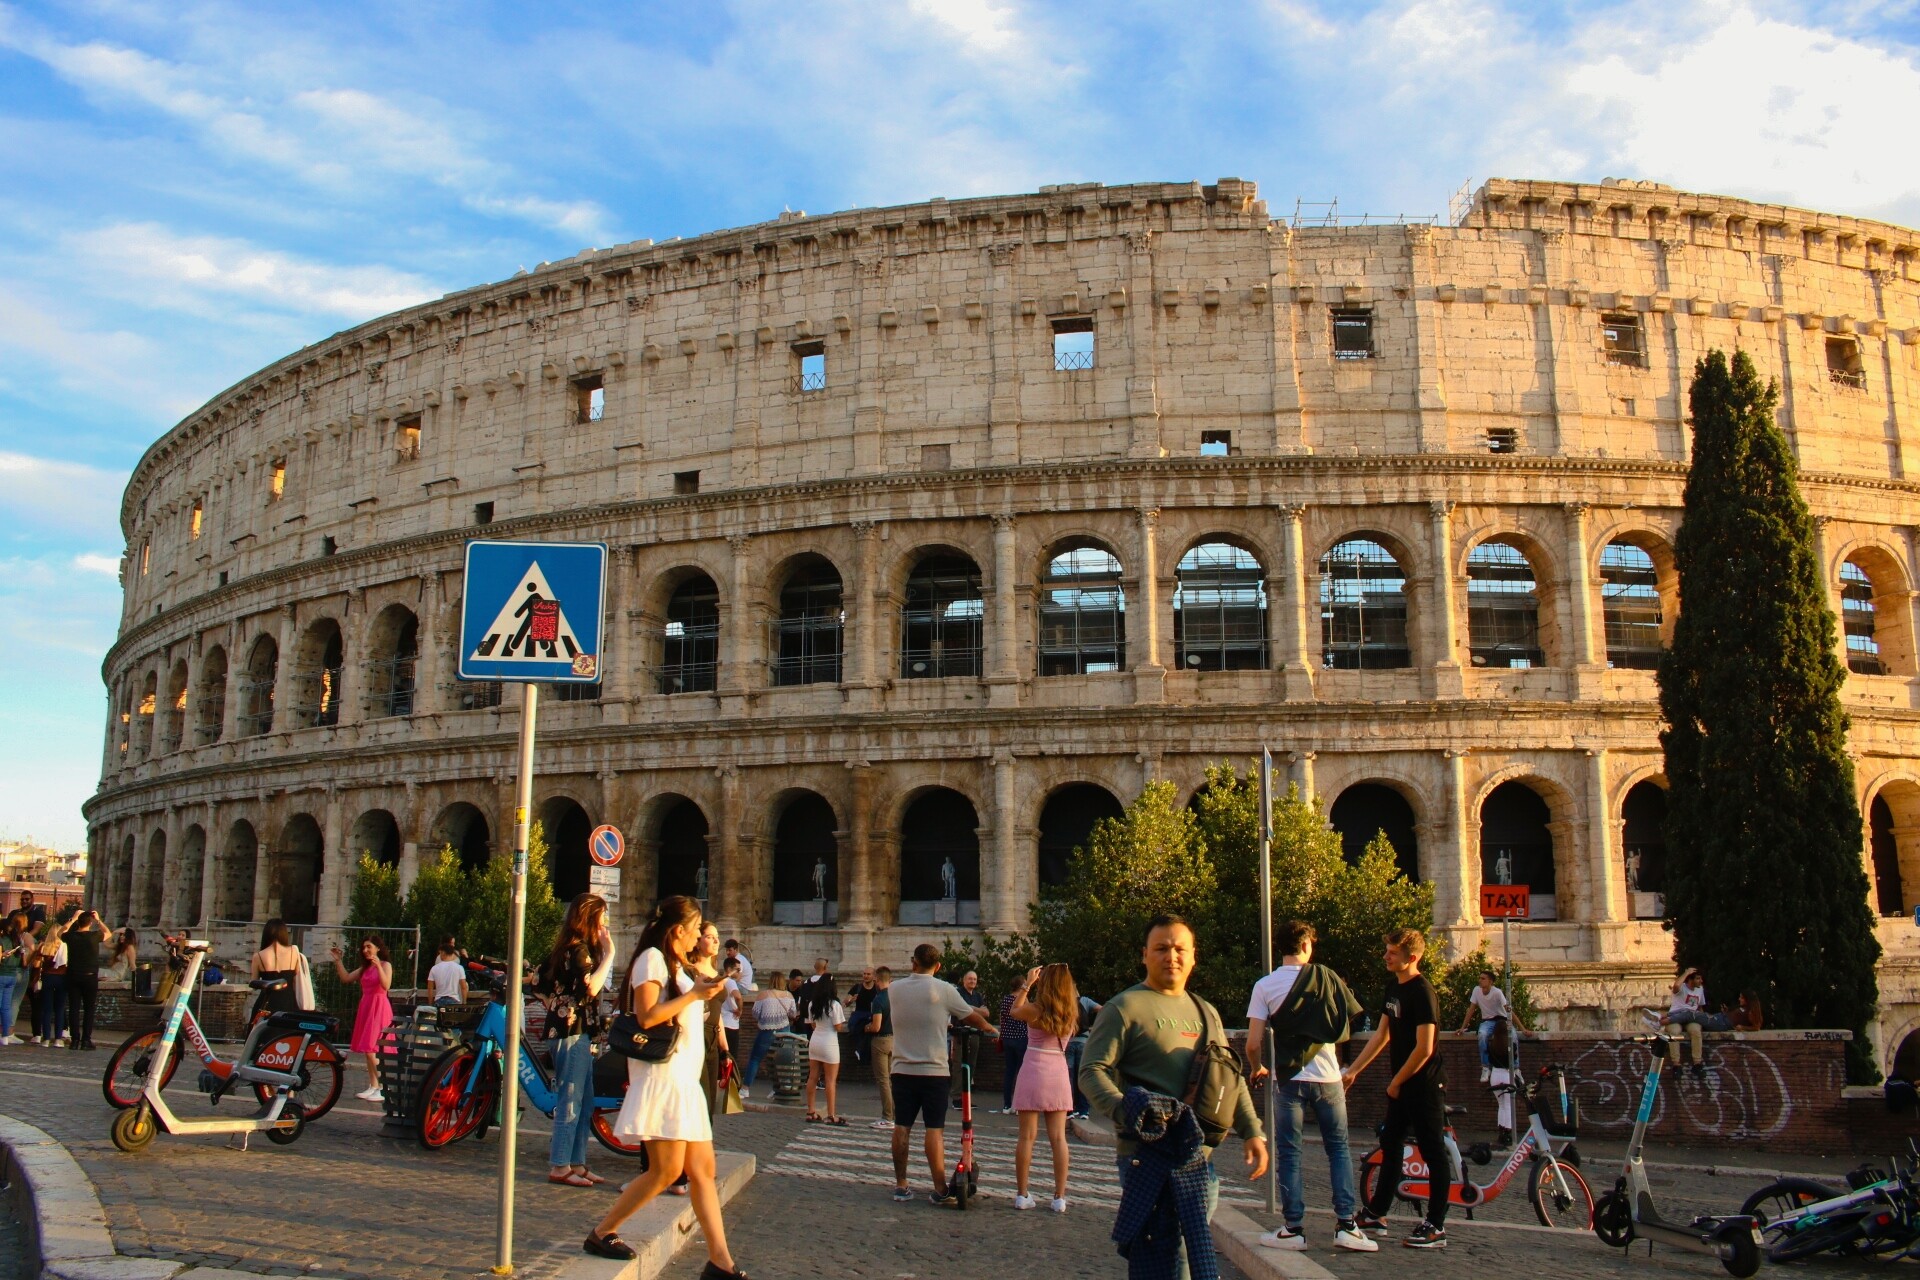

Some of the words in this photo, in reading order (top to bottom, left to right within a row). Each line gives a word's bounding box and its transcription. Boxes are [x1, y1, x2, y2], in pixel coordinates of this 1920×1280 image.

[1484, 893, 1526, 908] TAXI
[167, 1002, 184, 1034] BIRD
[1157, 1017, 1203, 1031] PRAD
[258, 1053, 294, 1066] ROMA
[518, 1053, 535, 1085] ott
